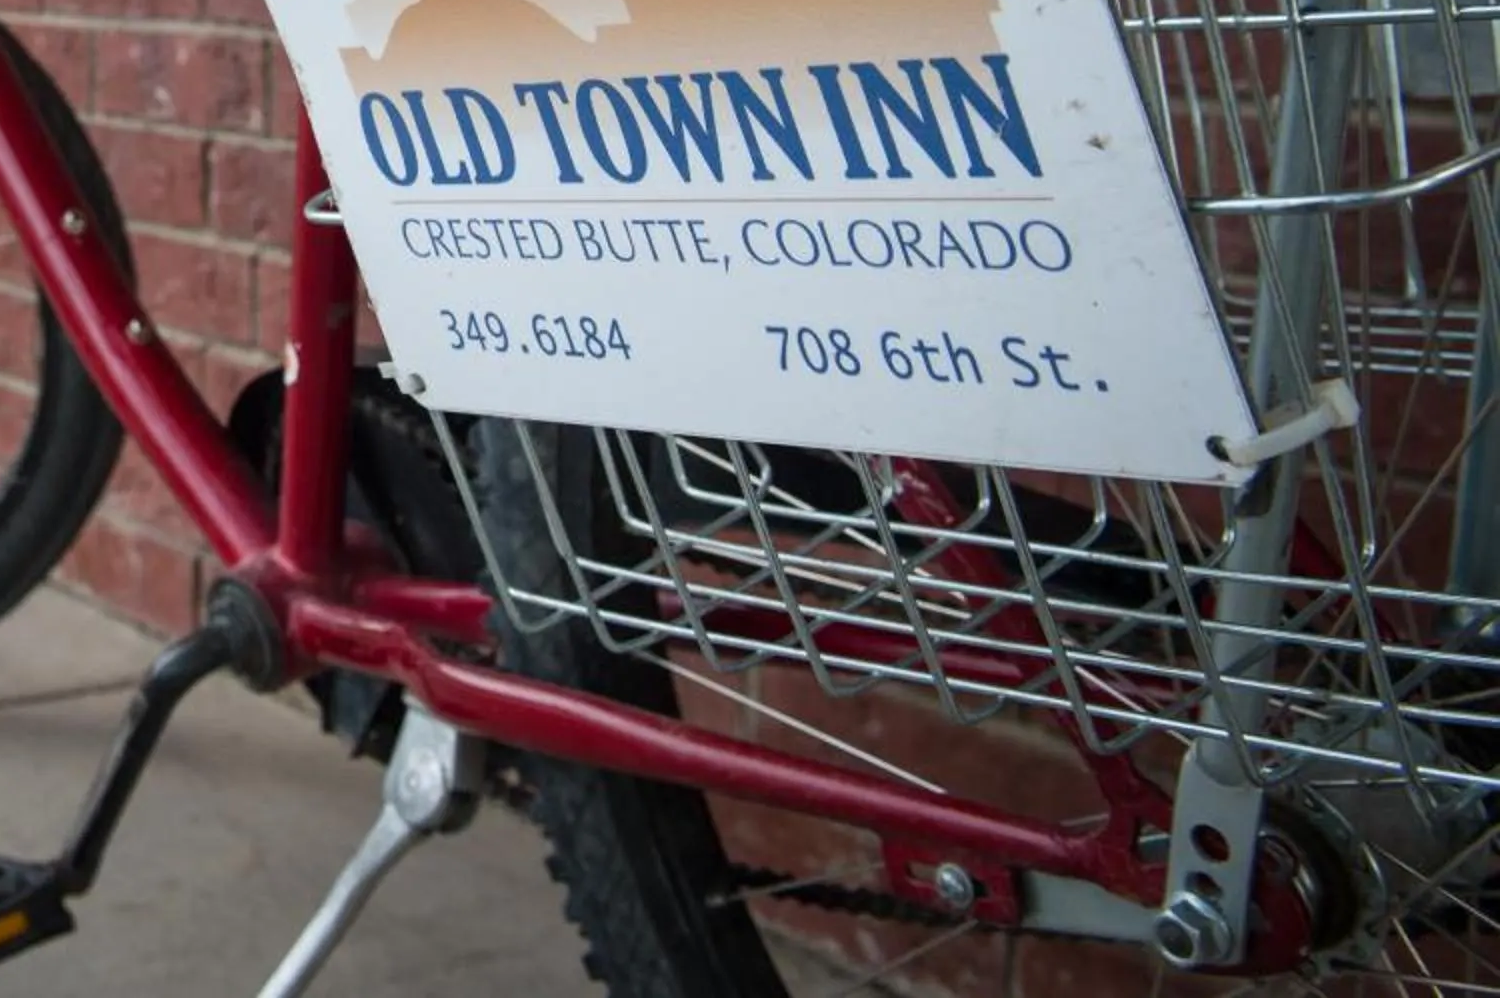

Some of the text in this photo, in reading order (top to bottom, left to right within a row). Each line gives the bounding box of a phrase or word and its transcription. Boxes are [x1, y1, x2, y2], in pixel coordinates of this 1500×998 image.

[359, 53, 1043, 187] OLD TOWN INN
[401, 218, 1074, 274] CRESTED BUTTE, COLORADO
[440, 309, 632, 360] 349.6184
[765, 325, 1110, 394] 708 6th St.
